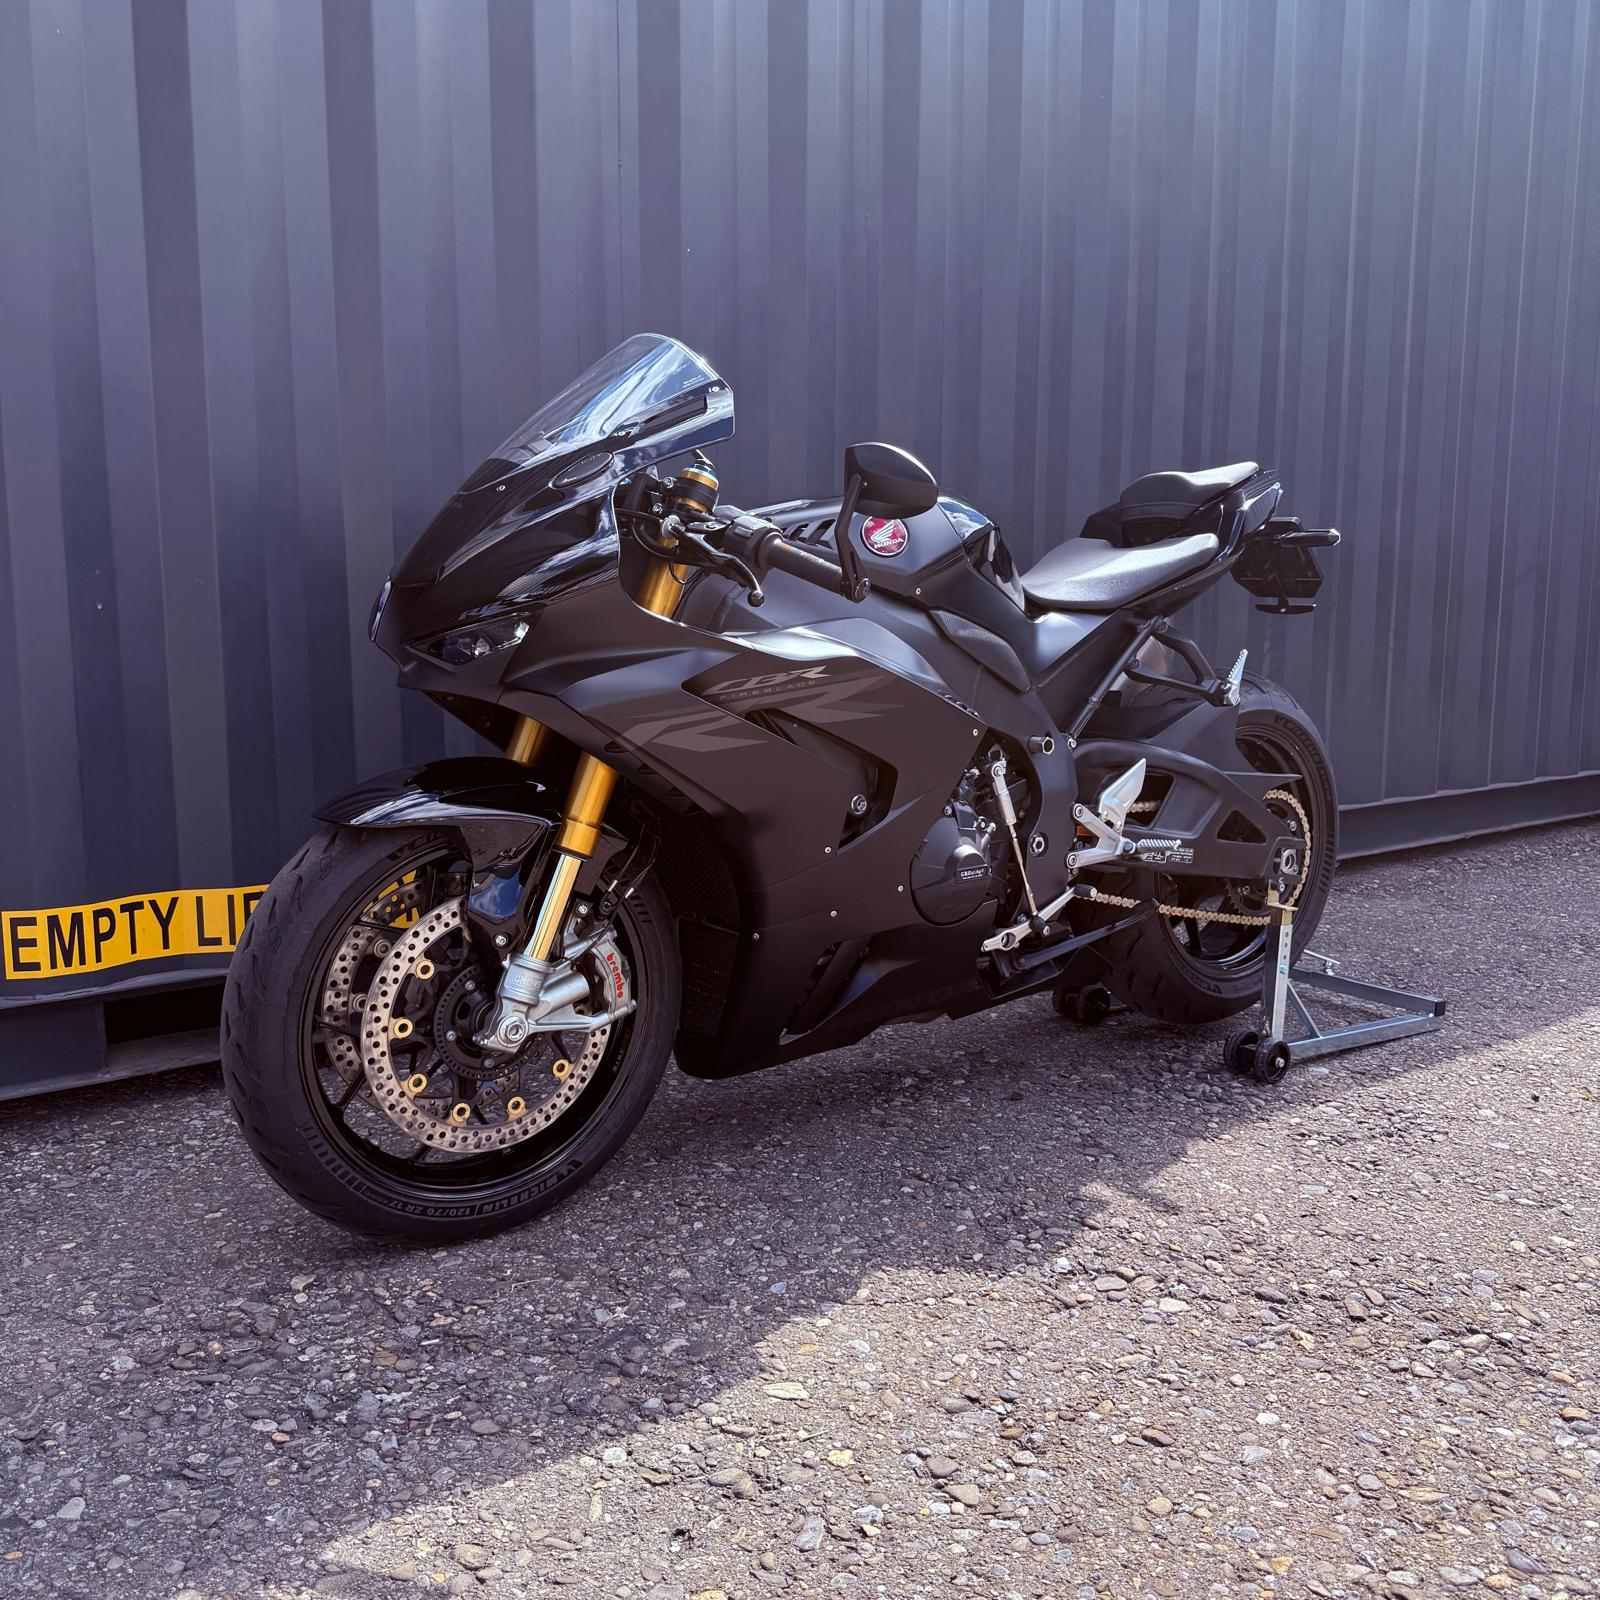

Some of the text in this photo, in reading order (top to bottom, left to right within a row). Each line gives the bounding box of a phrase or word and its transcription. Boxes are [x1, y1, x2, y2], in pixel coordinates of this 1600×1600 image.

[873, 537, 905, 549] HONDA
[701, 665, 831, 696] CBR
[719, 679, 817, 701] FIREBLADE
[9, 896, 180, 972] EMPTY
[606, 952, 625, 999] brembo
[389, 1173, 559, 1217] MICHELIN 120/70 ZR 17
